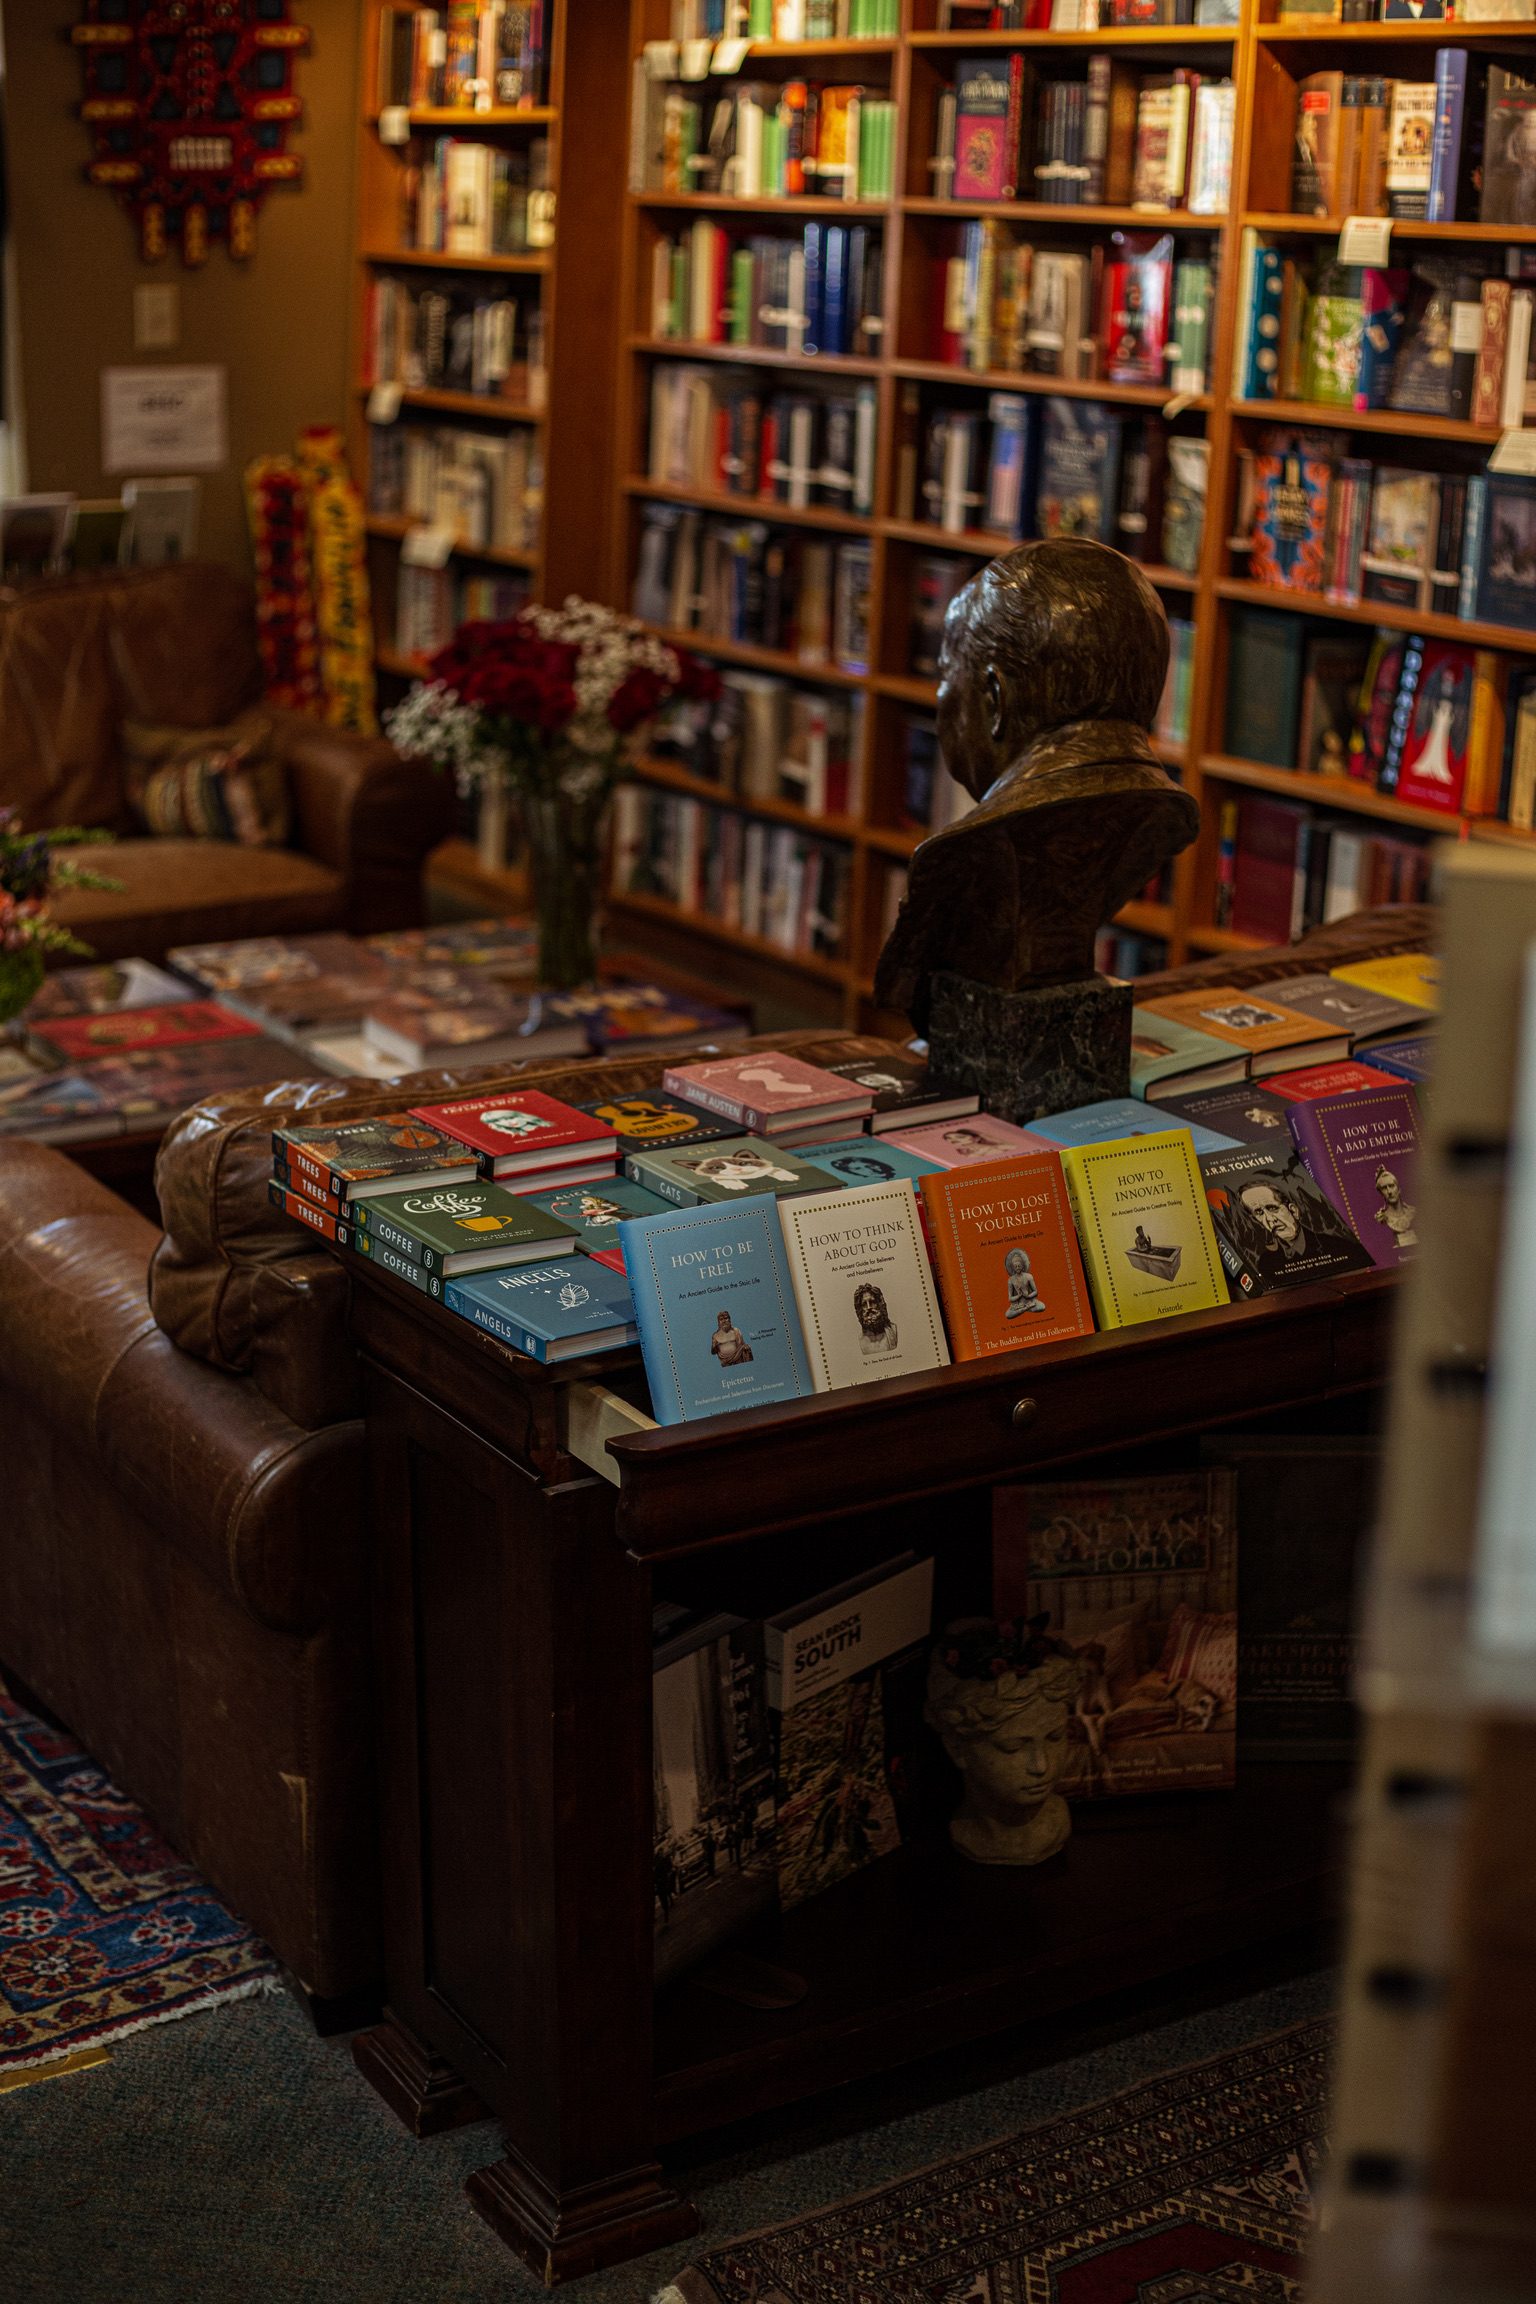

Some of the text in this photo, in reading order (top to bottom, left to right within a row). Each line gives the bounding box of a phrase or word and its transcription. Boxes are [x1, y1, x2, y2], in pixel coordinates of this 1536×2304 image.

[686, 1081, 741, 1119] JANE AUSTEN
[1342, 1119, 1400, 1139] HOW TO BE
[1336, 1131, 1415, 1154] A BAD EMPEROR
[297, 1154, 320, 1179] TREES
[1117, 1169, 1164, 1186] HOW TO
[301, 1179, 327, 1203] TREES
[403, 1192, 487, 1214] Coffee
[659, 1182, 681, 1201] CATS
[1115, 1182, 1173, 1202] INNOVATE
[297, 1204, 324, 1228] TREES
[960, 1192, 1052, 1221] HOW TO LOSE
[1118, 1208, 1133, 1216] Ancient
[1134, 1205, 1146, 1213] Guide
[1151, 1202, 1167, 1210] Creative
[1167, 1200, 1183, 1208] Thinking
[809, 1220, 905, 1247] HOW TO THINK
[974, 1210, 1043, 1234] YOURSELF
[379, 1224, 413, 1253] COFFEE
[824, 1238, 897, 1261] ABOUT GOD
[383, 1251, 418, 1281] COFFEE
[671, 1240, 754, 1268] HOW TO BE
[839, 1263, 855, 1271] Ancient
[855, 1260, 869, 1268] Guide
[876, 1255, 895, 1264] Believers
[1218, 1240, 1238, 1271] KIEN
[498, 1267, 571, 1290] ANGELS
[699, 1261, 734, 1279] FREE
[855, 1266, 884, 1277] Nonbelievers
[687, 1289, 707, 1298] Ancient
[707, 1285, 723, 1294] Guide
[738, 1279, 751, 1287] Stoic
[1157, 1303, 1183, 1315] Aristotle
[474, 1309, 511, 1338] ANGELS
[985, 1325, 1076, 1350] The Buddha and His Followers
[721, 1375, 754, 1389] Epictetus
[1093, 1538, 1193, 1572] FOLLY
[796, 1612, 861, 1653] SEAN BROCK
[794, 1625, 862, 1674] SOUTH
